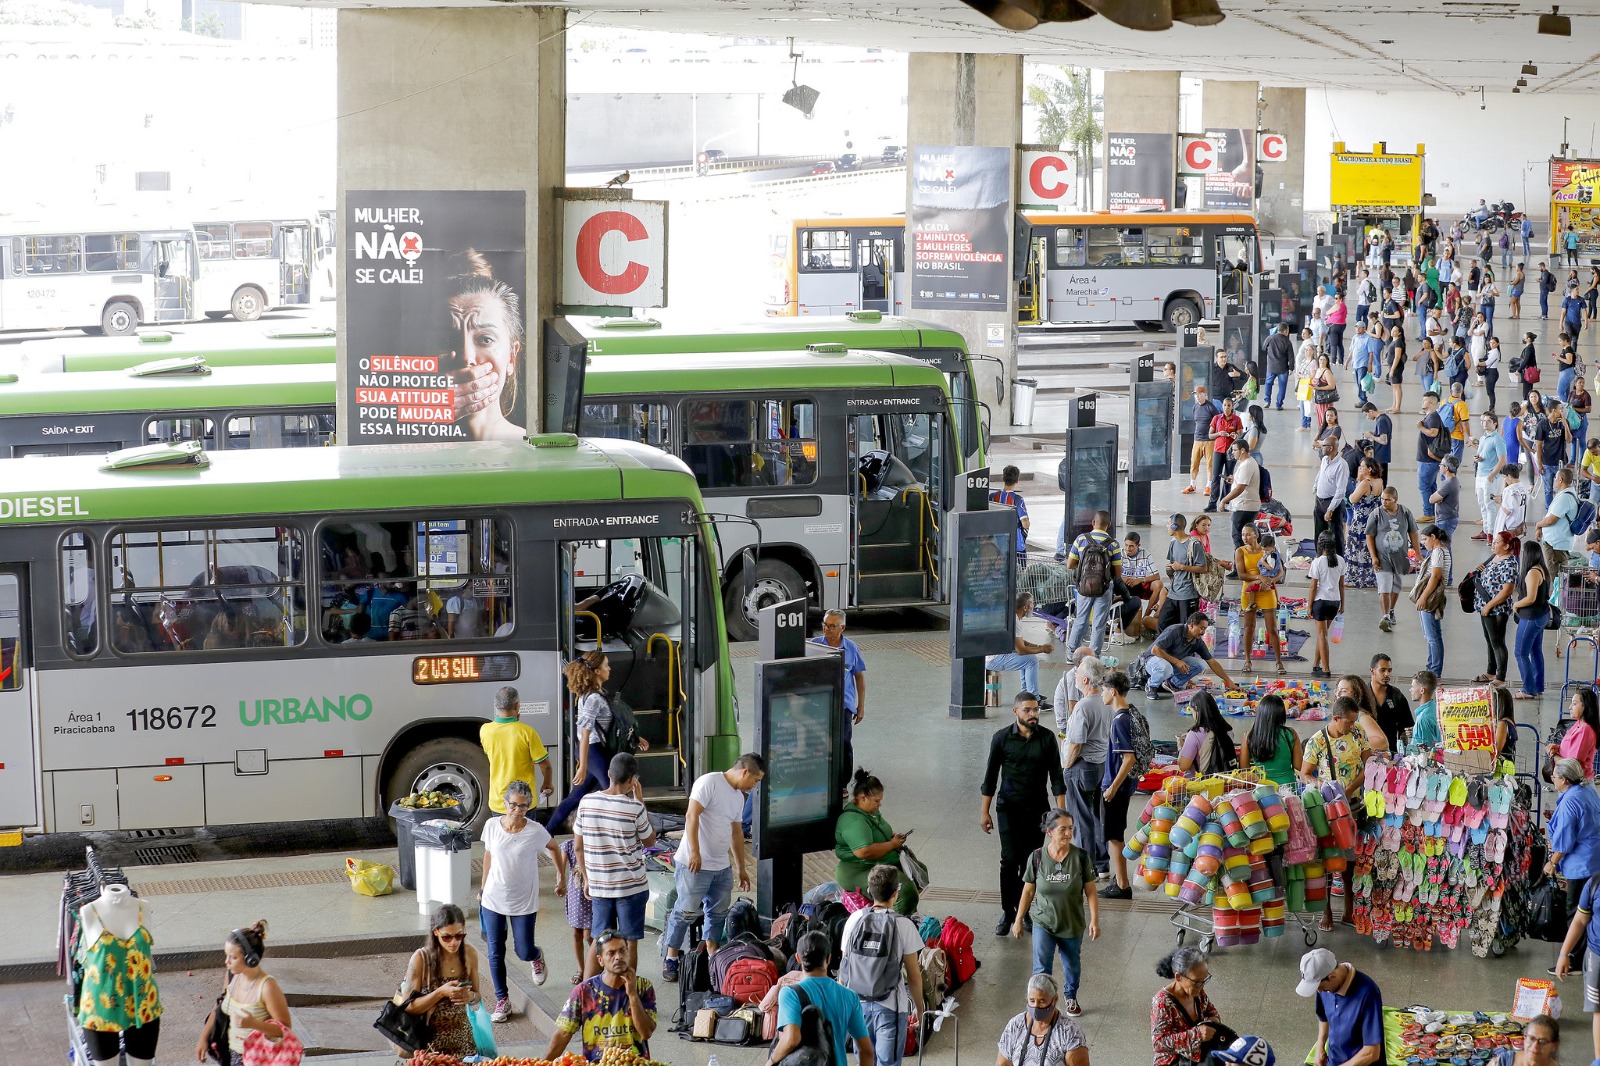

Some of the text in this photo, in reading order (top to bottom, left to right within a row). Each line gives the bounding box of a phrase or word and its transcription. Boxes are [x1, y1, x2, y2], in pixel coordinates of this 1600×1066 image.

[1110, 144, 1136, 159] NÃO
[1263, 136, 1283, 158] C
[1186, 140, 1212, 170] C
[1029, 156, 1070, 199] C
[355, 208, 424, 225] MULHER,
[355, 224, 423, 262] NÃO
[924, 234, 969, 243] MINUTOS,
[576, 211, 650, 295] C
[916, 252, 1002, 262] SOFREM VIOLÊNCIA
[932, 262, 964, 270] BRASIL.
[356, 268, 423, 284] SE CALE!
[1070, 274, 1089, 284] Área
[359, 356, 435, 371] O SILÊNCIO
[1145, 360, 1154, 368] 04
[359, 372, 458, 388] NÃO PROTEGE.
[360, 390, 449, 404] SUA ATITUDE
[1079, 401, 1095, 409] C 03
[360, 407, 452, 420] PODE MUDAR
[42, 425, 95, 435] SAÍDA EXIT
[360, 421, 466, 437] ESSA HISTÓRIA.
[967, 477, 988, 488] C 02
[0, 496, 89, 518] DIESEL
[554, 515, 659, 527] ENTRADA ENTRANCE
[777, 612, 803, 628] C 01
[452, 657, 479, 678] SUL
[1443, 692, 1480, 704] OFERTA
[68, 711, 101, 723] Área 1
[126, 705, 216, 730] 118672
[239, 693, 373, 727] URBANO
[53, 724, 115, 734] Piracicabana
[594, 1024, 636, 1036] Rakute
